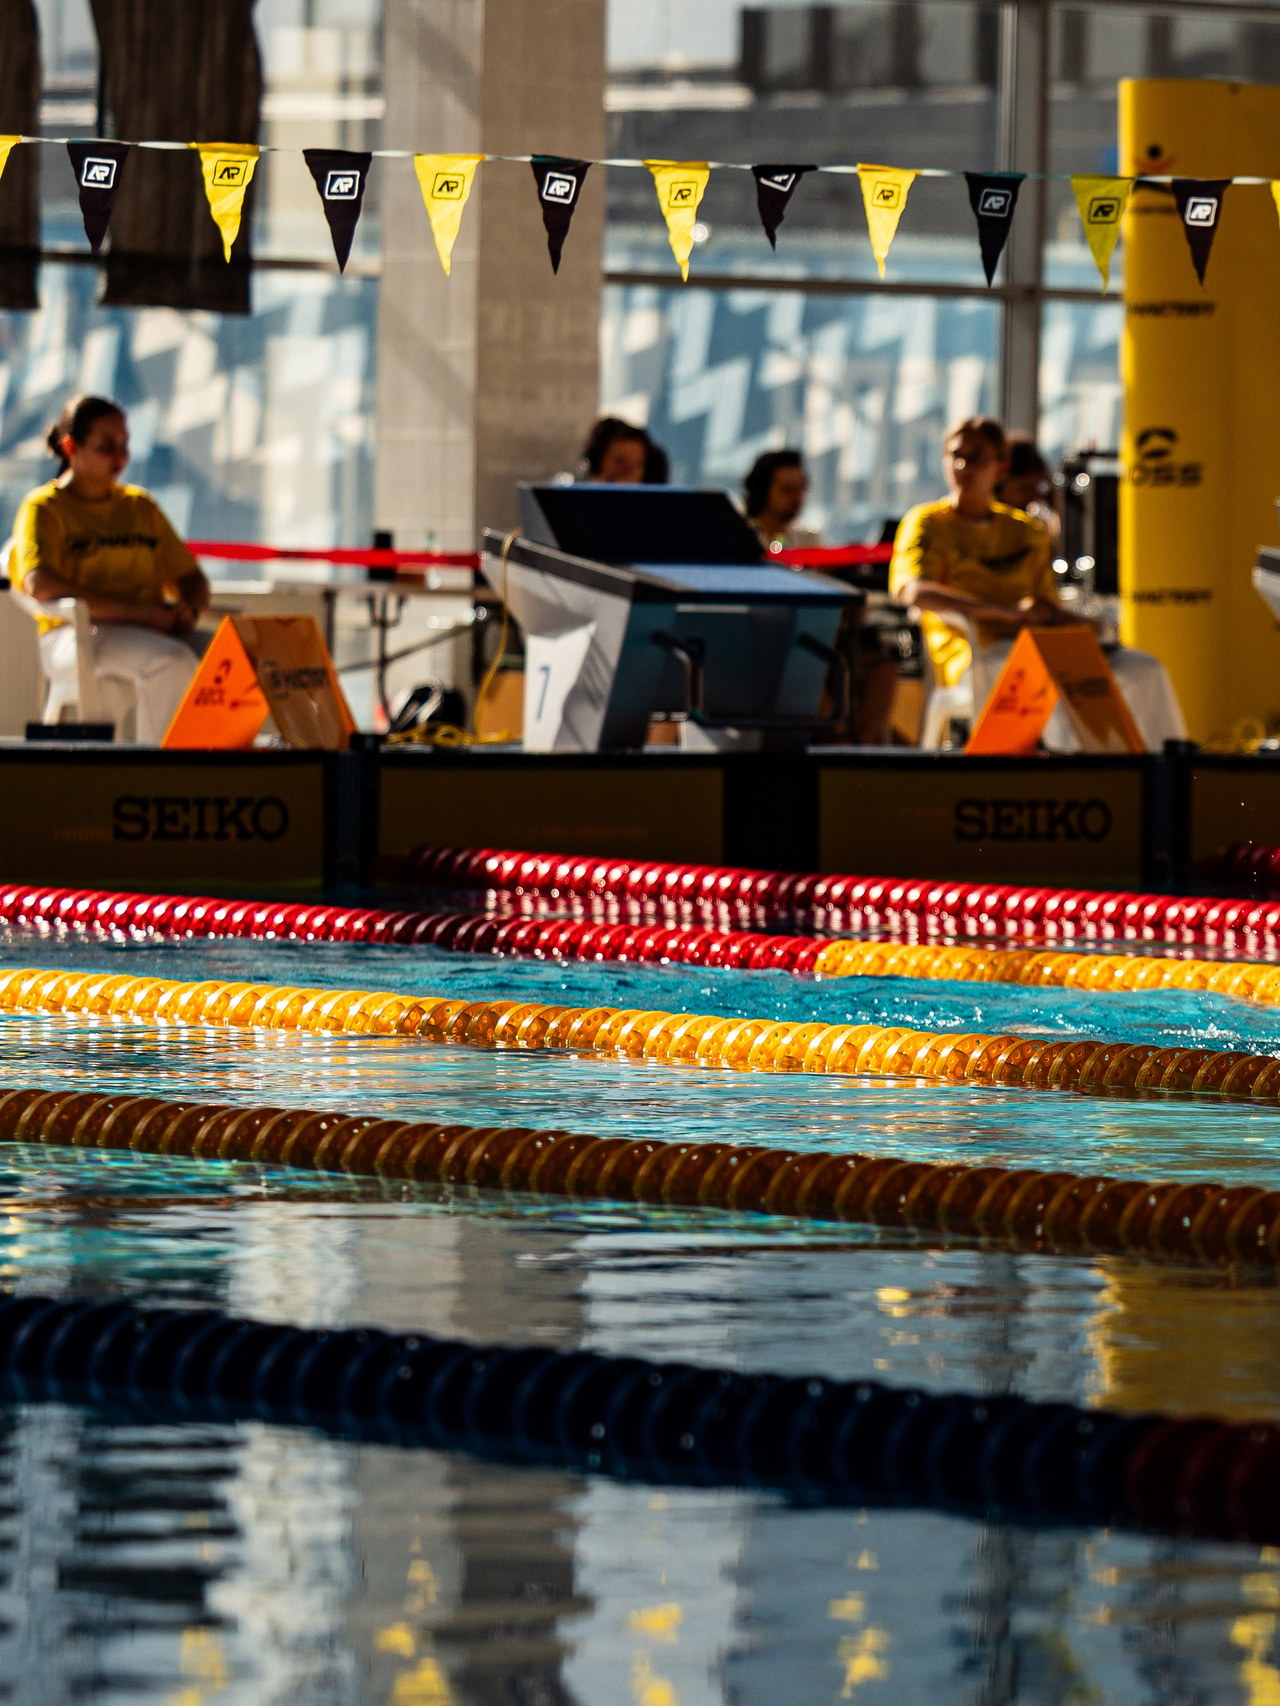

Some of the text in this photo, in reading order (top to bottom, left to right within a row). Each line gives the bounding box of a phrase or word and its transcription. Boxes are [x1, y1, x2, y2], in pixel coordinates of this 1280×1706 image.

[1129, 461, 1204, 488] OSS
[536, 664, 550, 721] 7
[112, 795, 290, 843] SEIKO
[954, 799, 1112, 842] SEIKO
